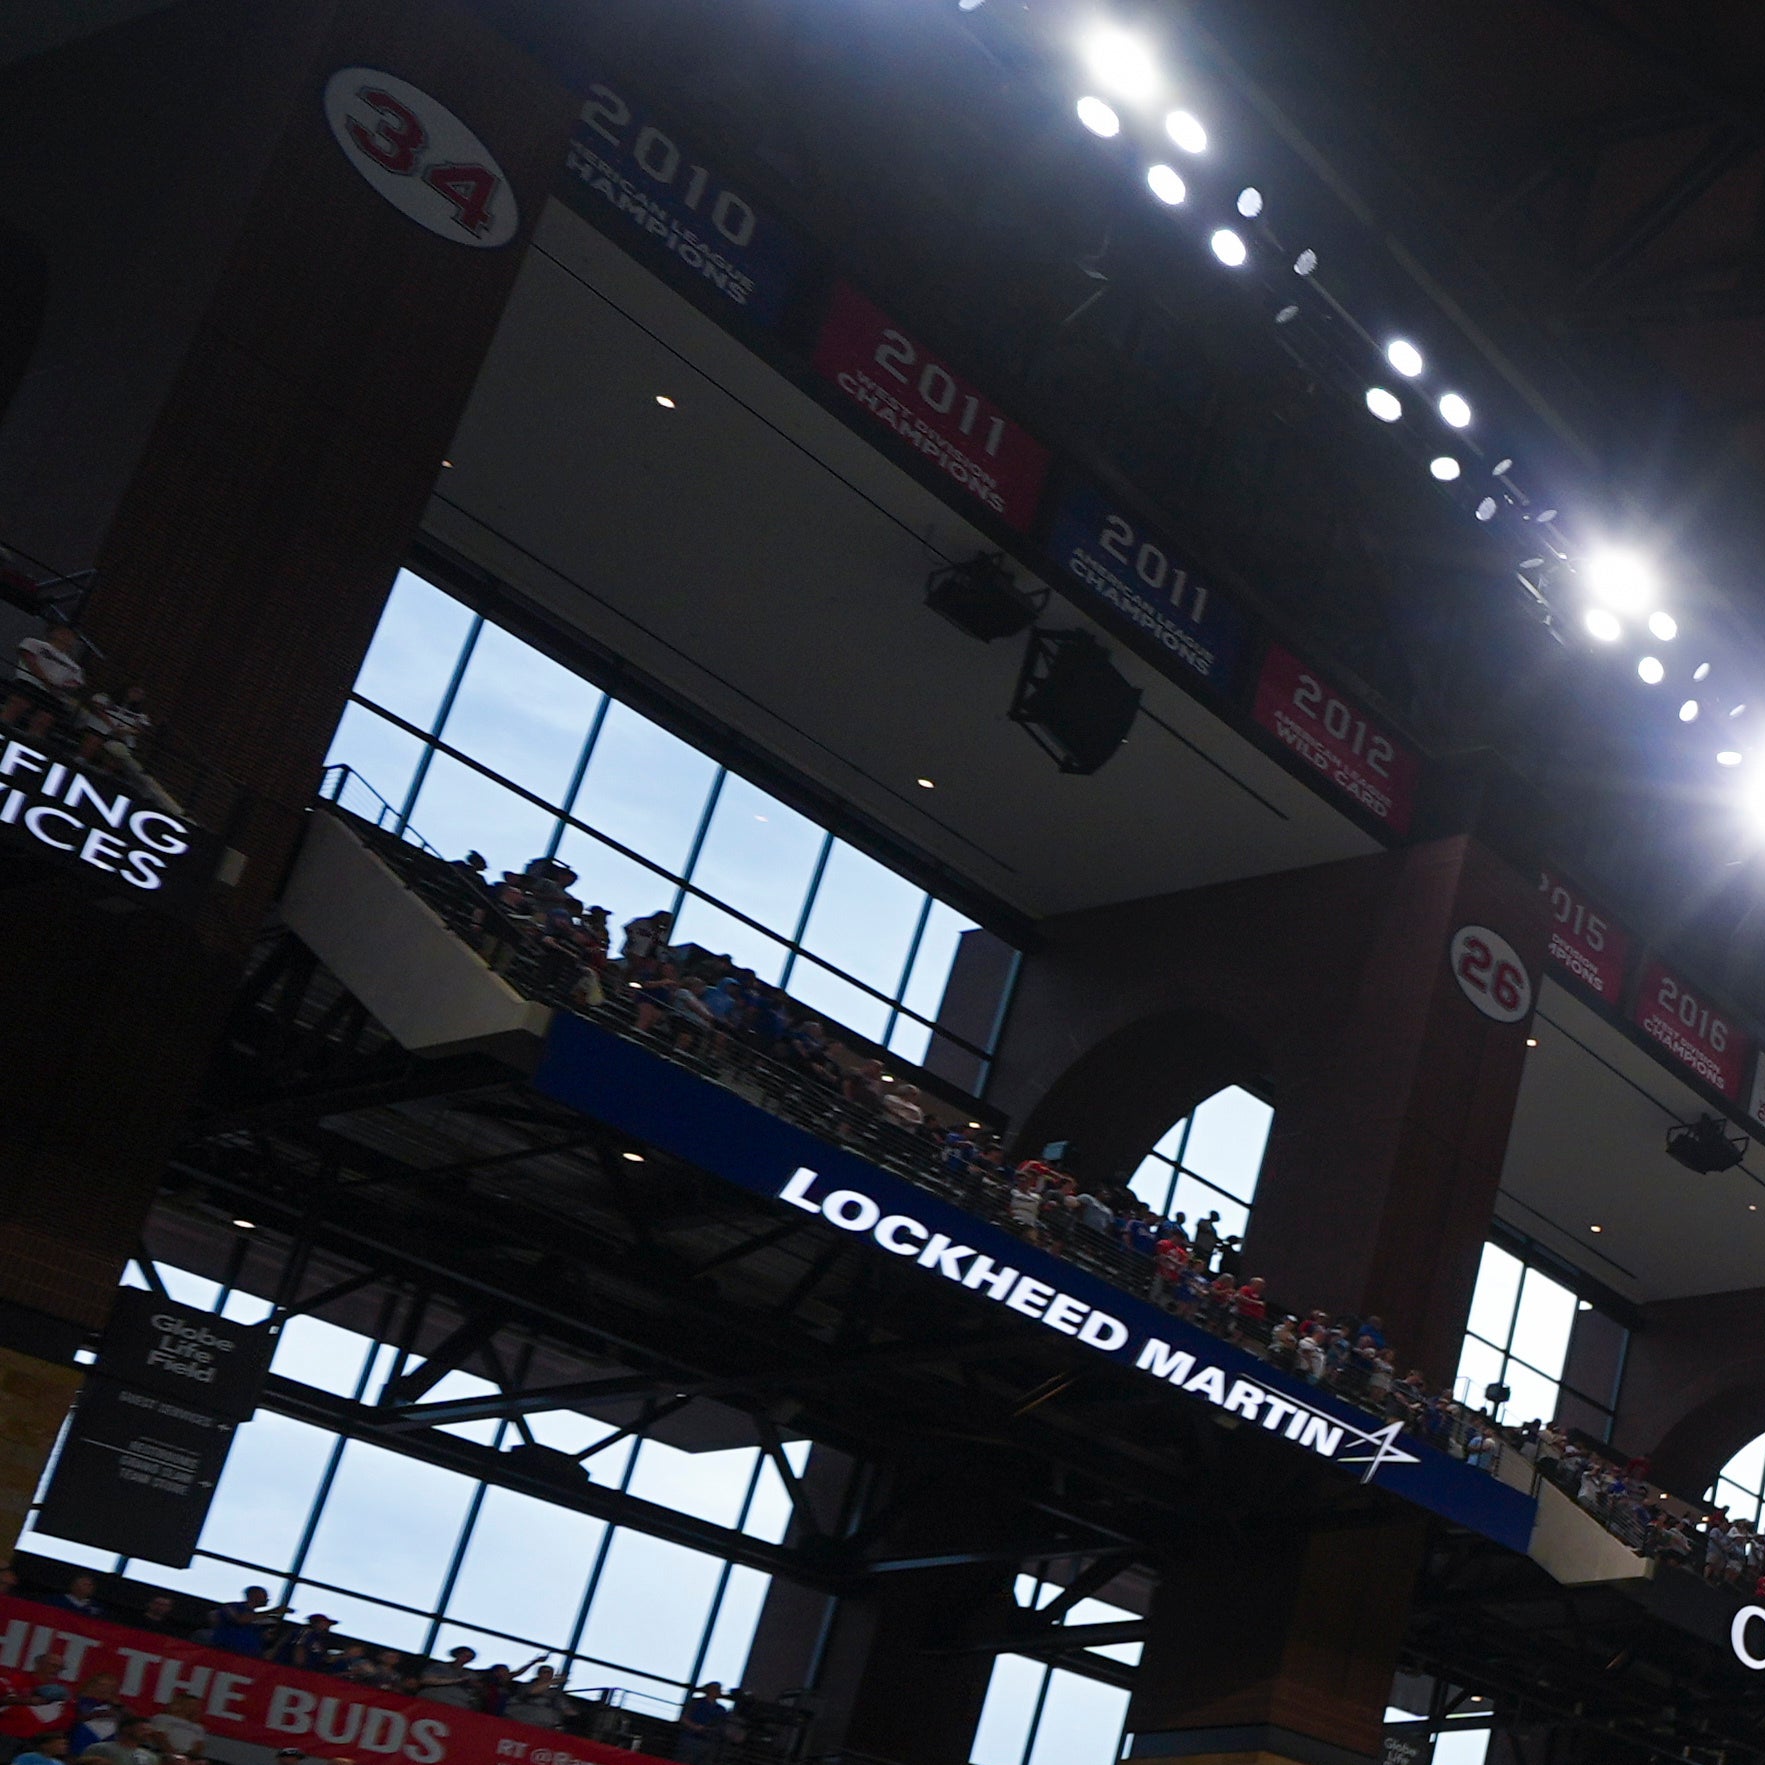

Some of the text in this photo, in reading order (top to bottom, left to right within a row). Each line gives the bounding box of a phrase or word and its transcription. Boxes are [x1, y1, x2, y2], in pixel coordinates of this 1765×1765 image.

[345, 86, 503, 241] 34
[580, 83, 757, 248] 2010
[836, 371, 1005, 514] CHAMPIONS
[873, 327, 1006, 457] 2011
[1069, 557, 1211, 677] CHAMPIONS
[1100, 513, 1209, 625] 2011
[1276, 719, 1389, 818] WILD CARD
[1292, 674, 1396, 780] 2012
[0, 733, 192, 856] FING
[0, 781, 169, 892] ICES
[1458, 935, 1525, 1014] 26
[1657, 976, 1729, 1053] 2016
[1642, 1017, 1726, 1091] CHAMPIONS
[150, 1312, 237, 1355] Globe
[161, 1334, 214, 1365] Life
[777, 1165, 1348, 1460] LOCKHEED MARTIN
[145, 1348, 218, 1385] Field
[117, 1646, 257, 1722] THE
[495, 1737, 531, 1758] RT
